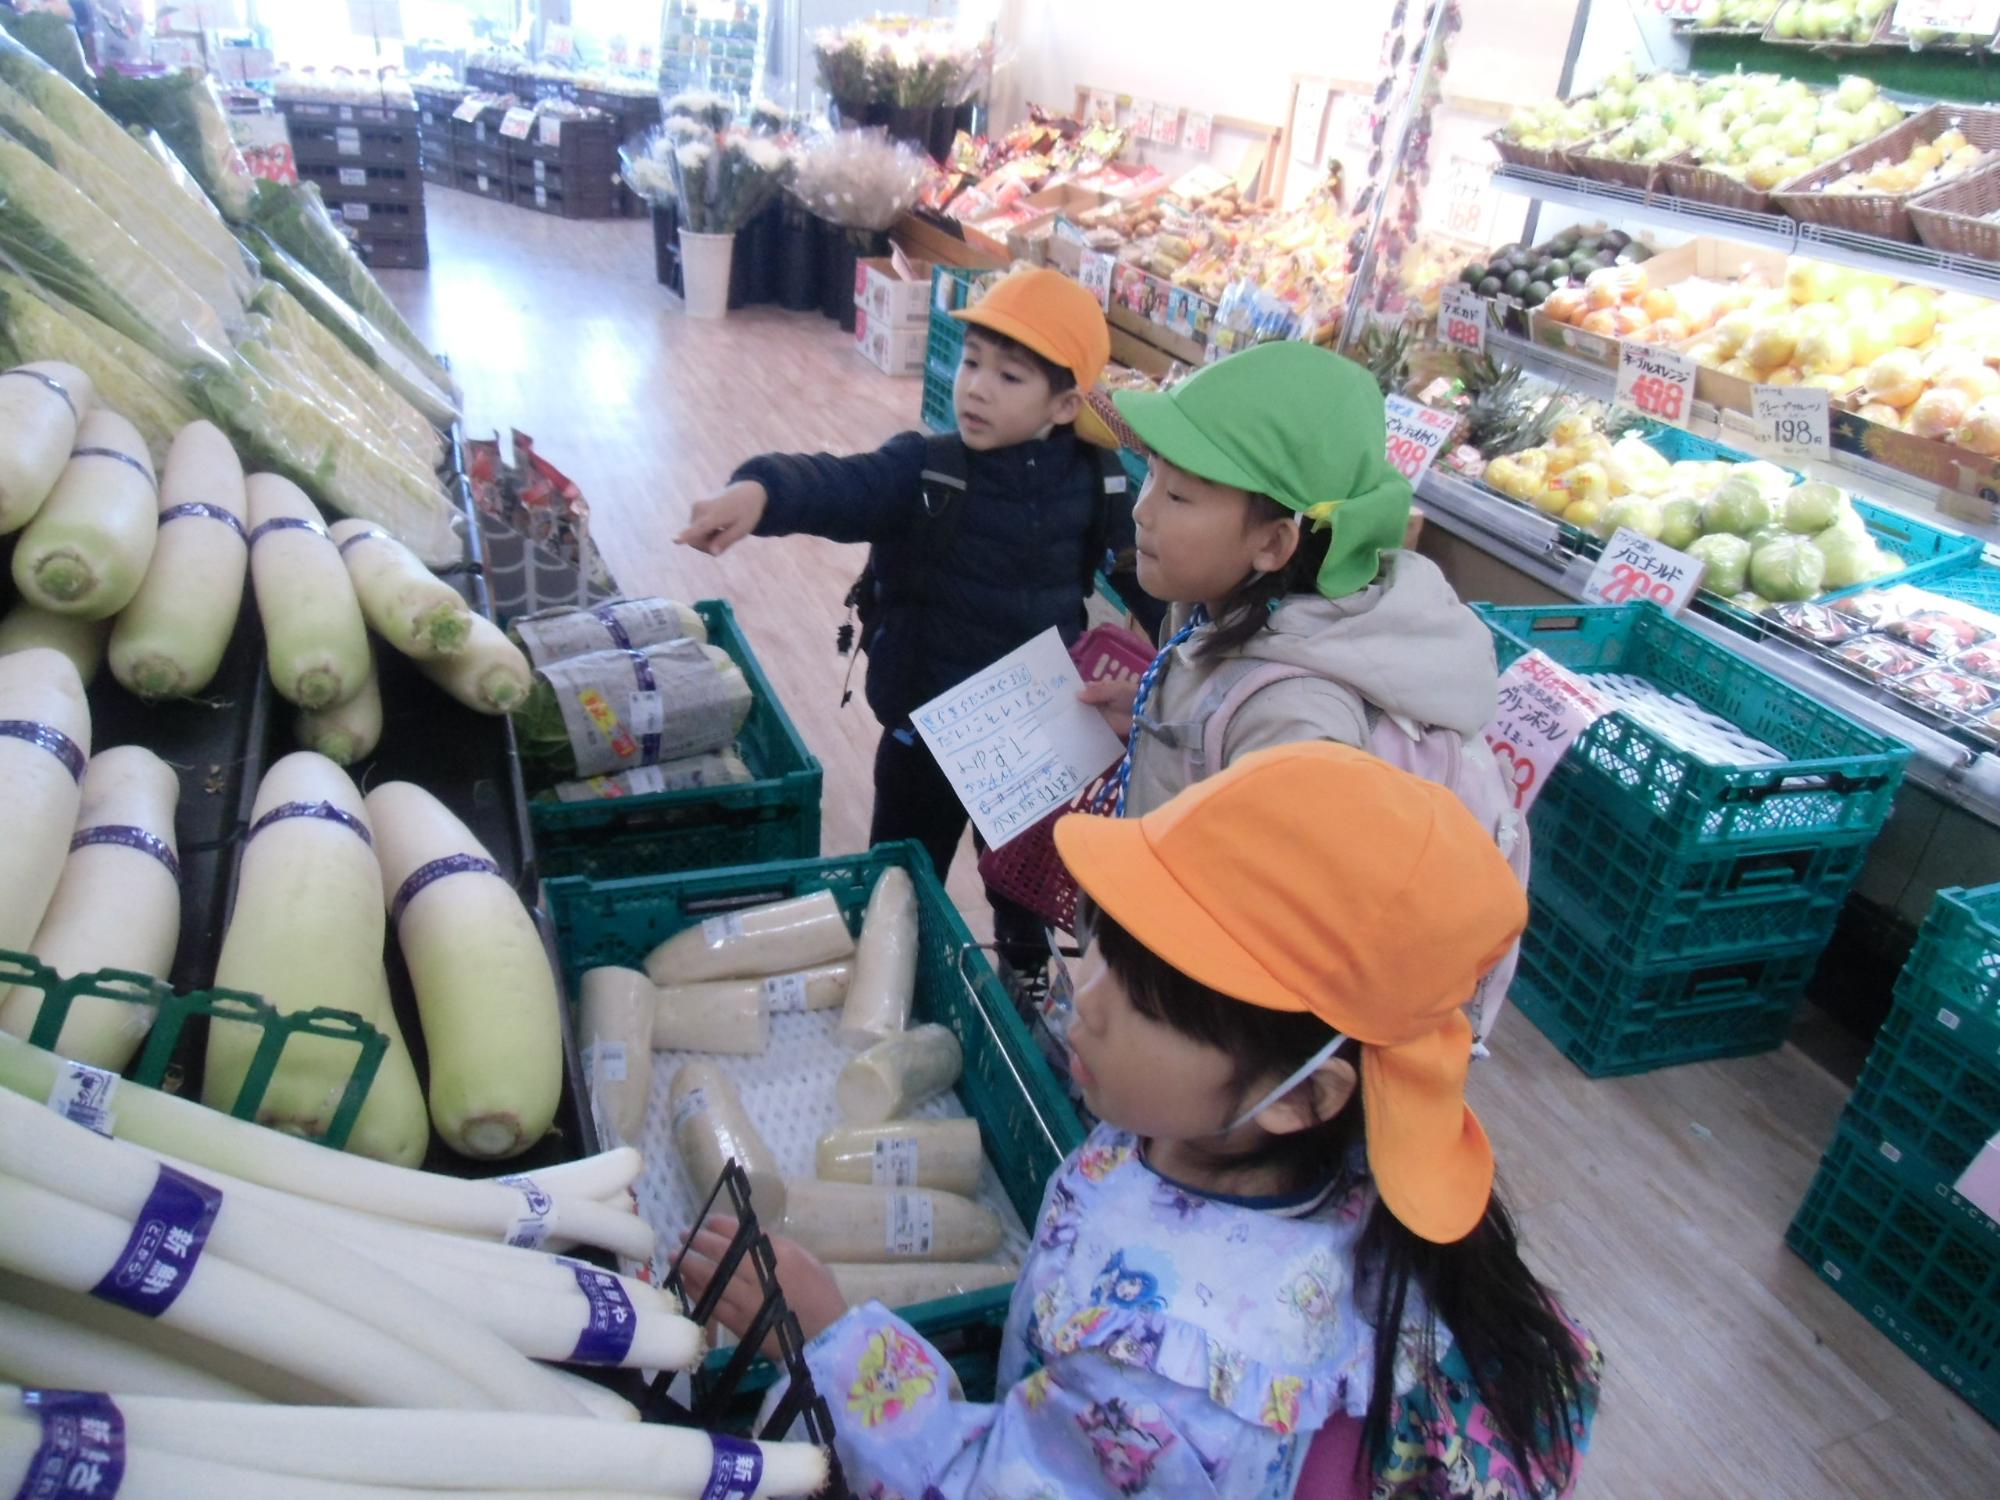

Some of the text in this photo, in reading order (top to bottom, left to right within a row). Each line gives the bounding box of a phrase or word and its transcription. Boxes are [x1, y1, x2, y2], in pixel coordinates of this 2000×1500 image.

[1611, 547, 1685, 582] メロゴールド
[1498, 685, 1568, 741] グリーンボール
